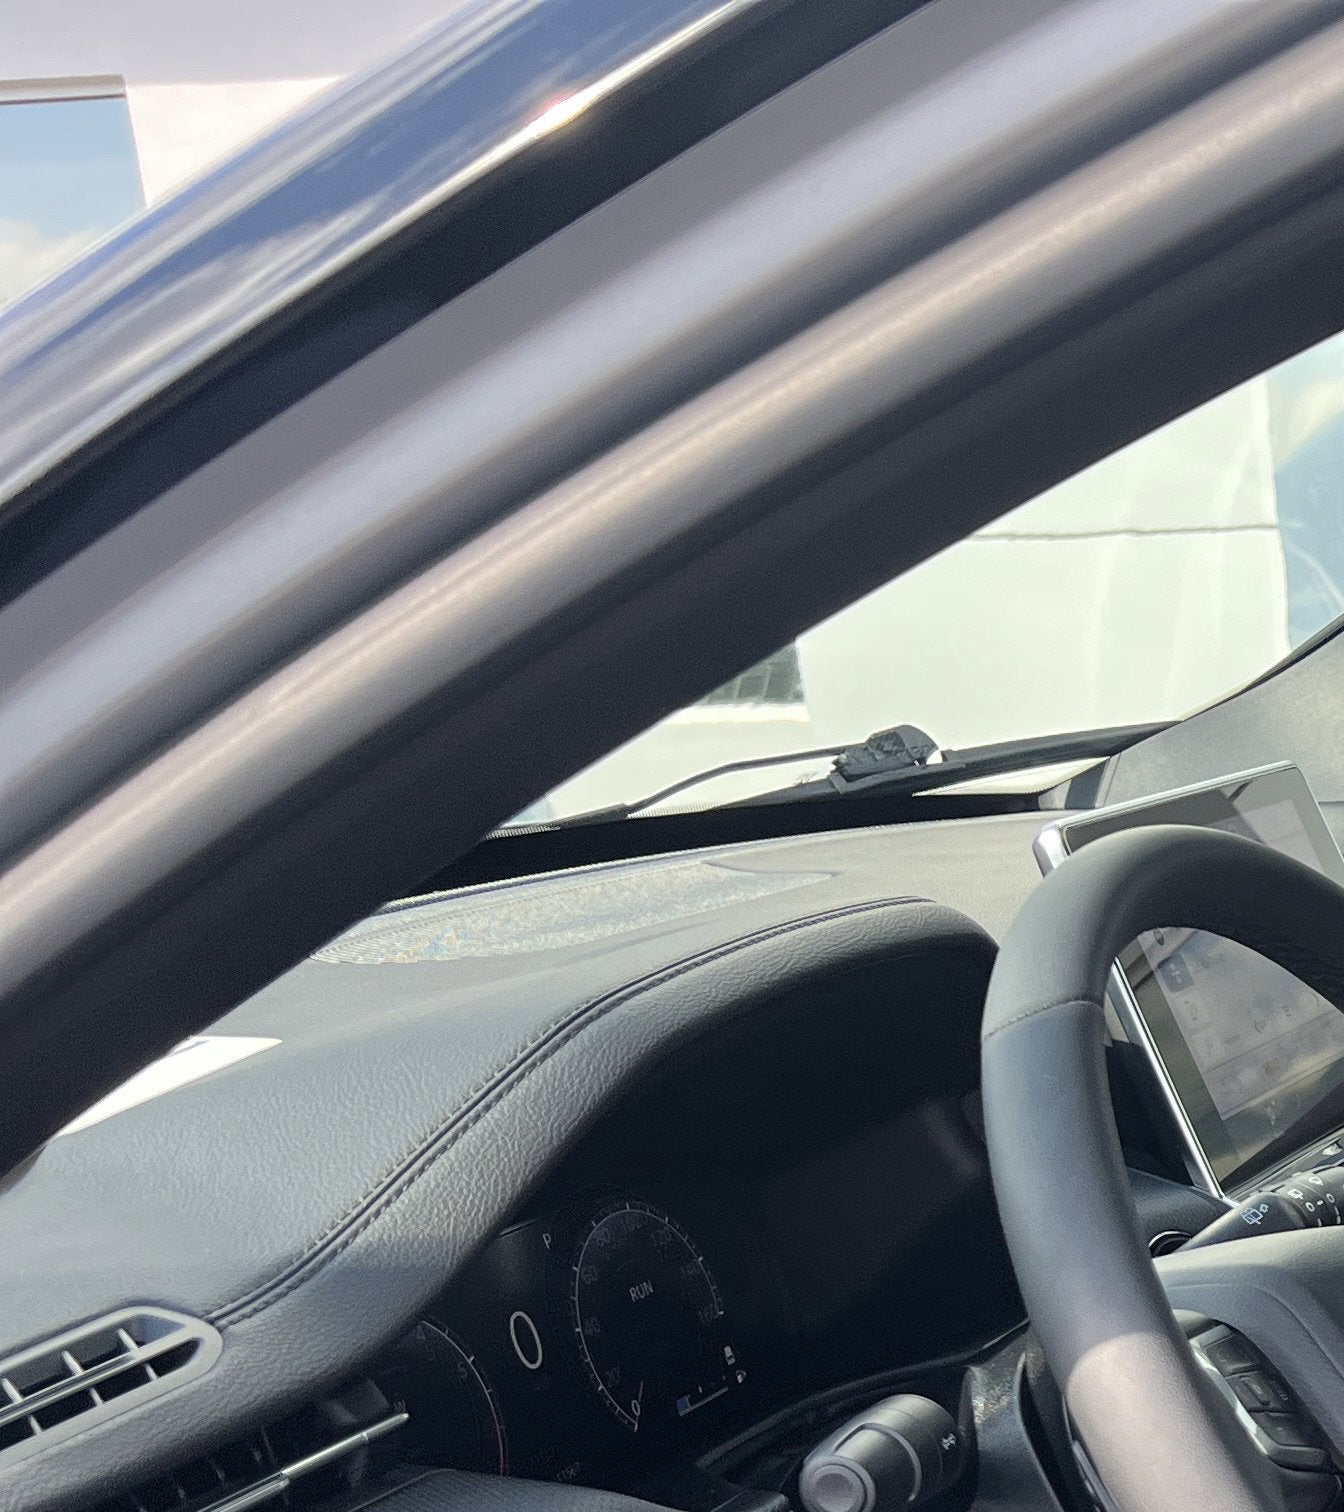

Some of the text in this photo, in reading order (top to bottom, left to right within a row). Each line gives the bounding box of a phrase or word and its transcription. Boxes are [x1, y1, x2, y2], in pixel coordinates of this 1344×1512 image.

[543, 1233, 552, 1249] P
[629, 1280, 654, 1302] RUN
[510, 1311, 542, 1369] 0
